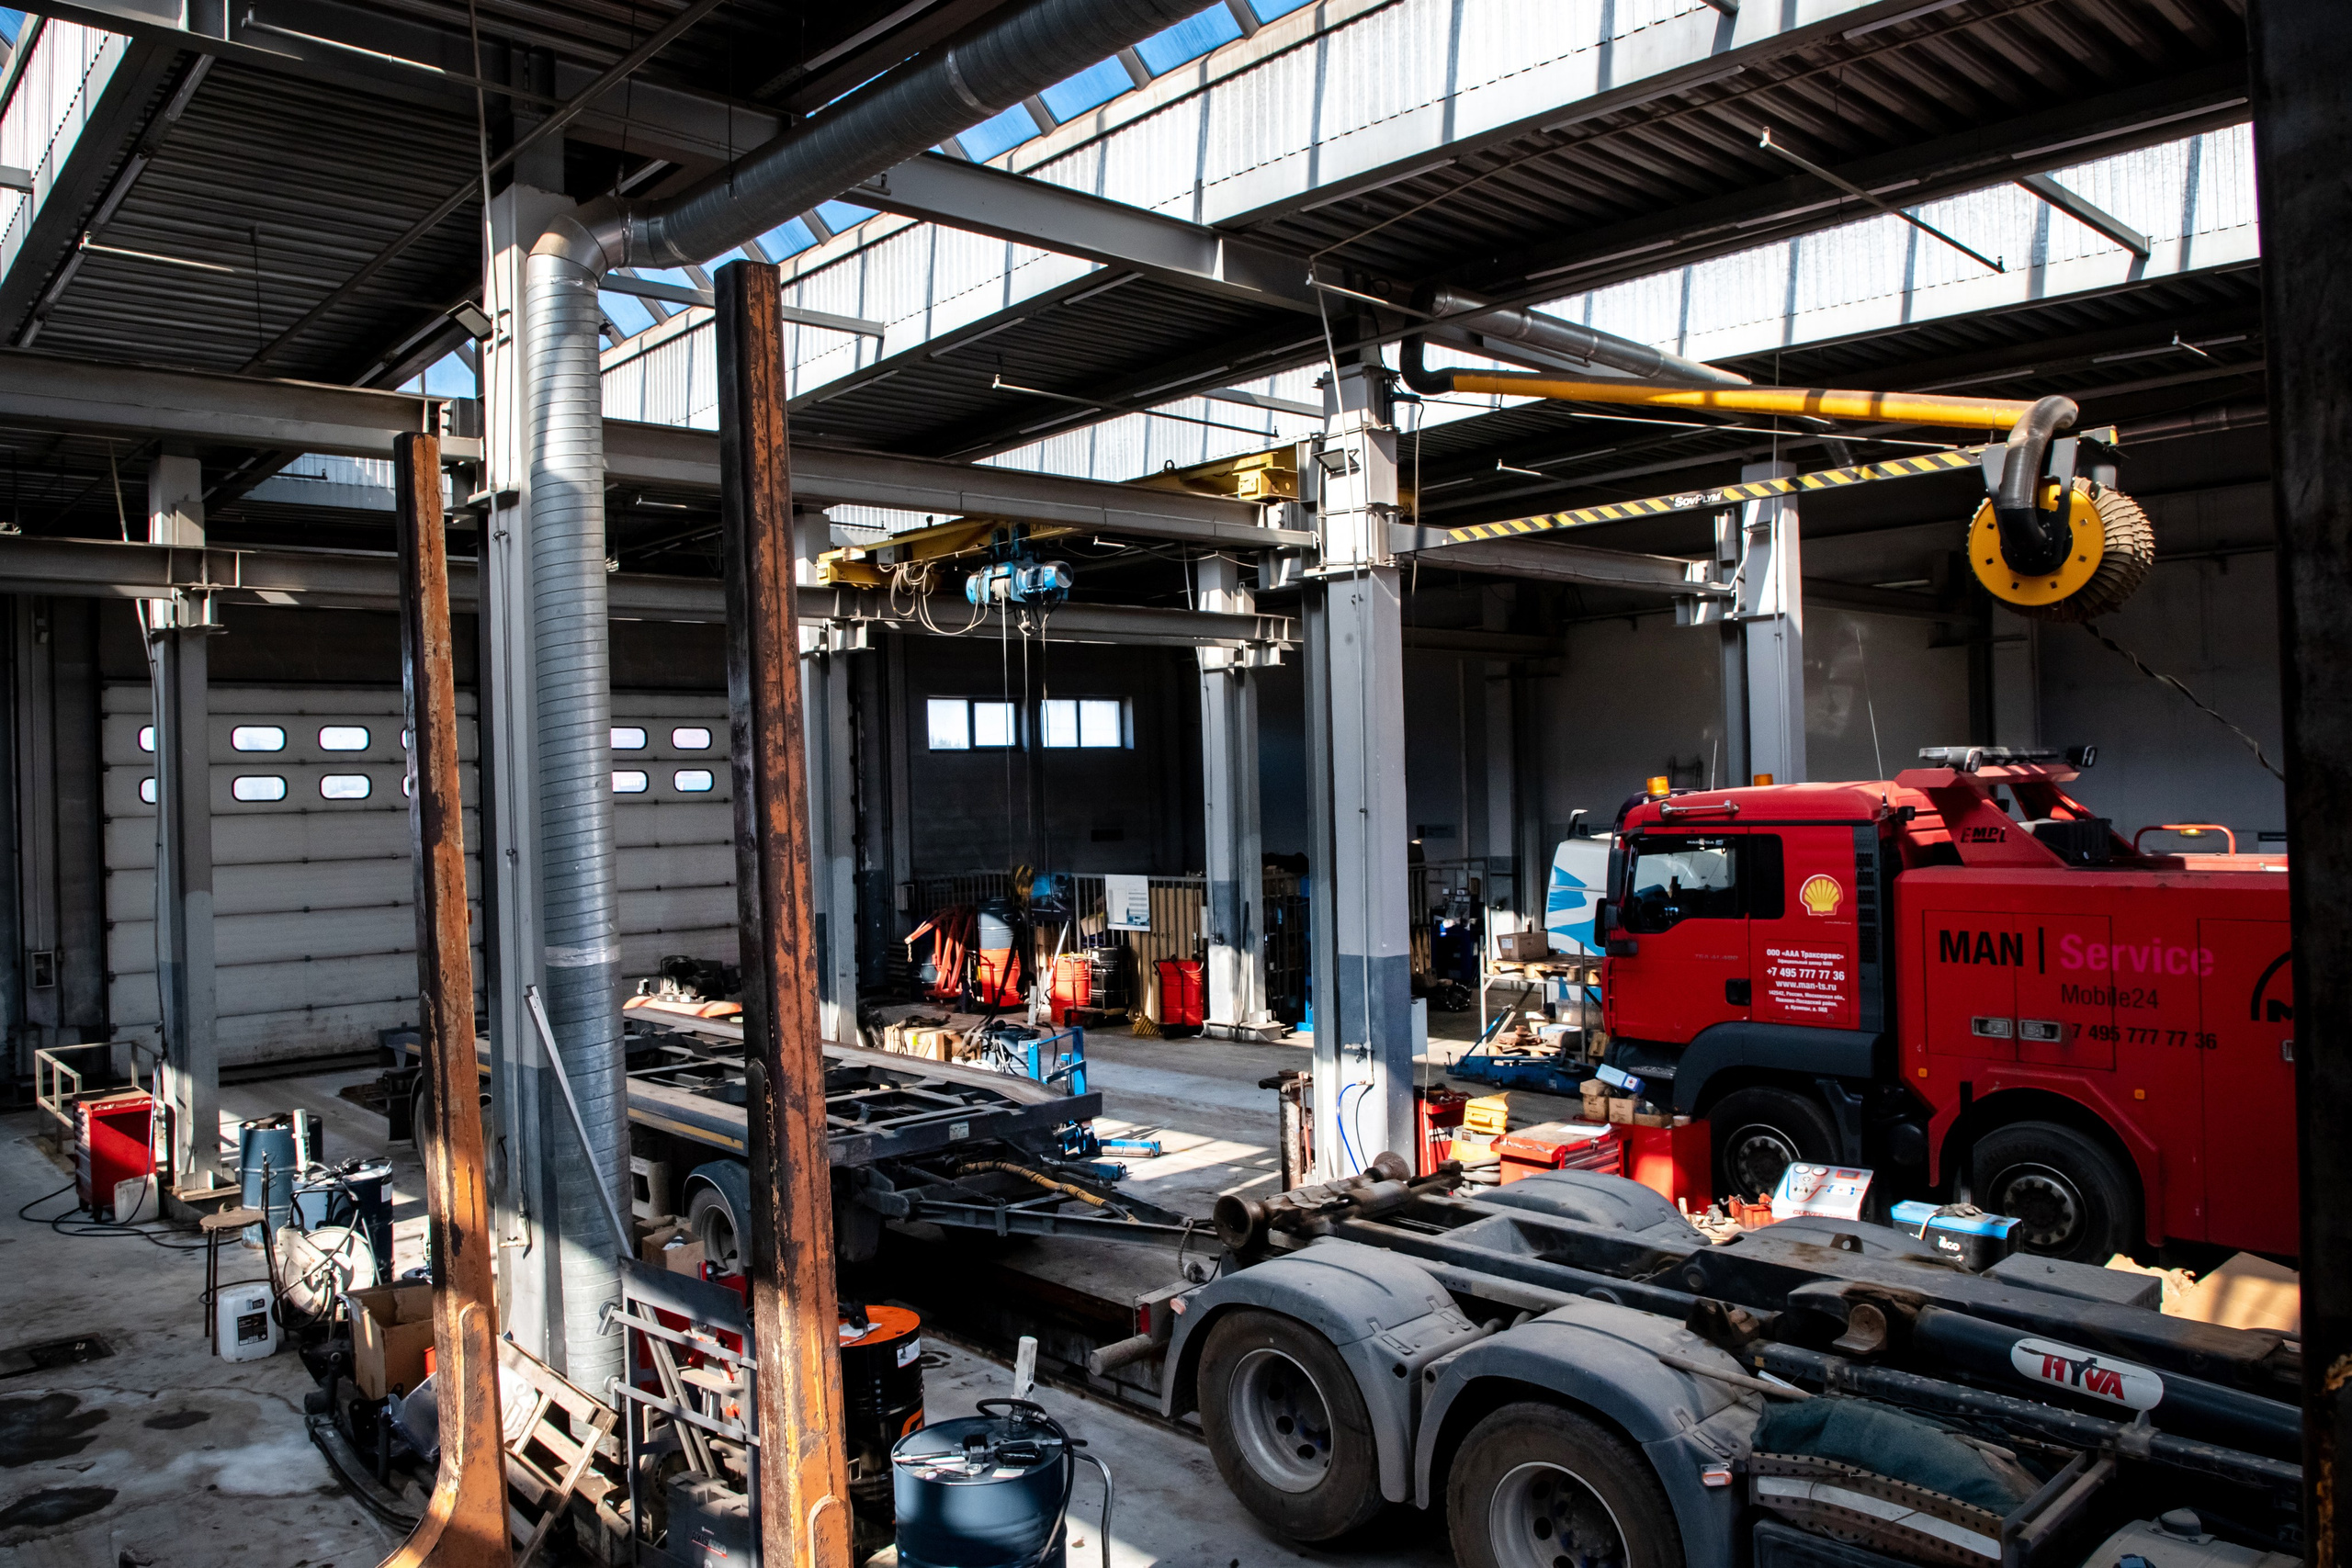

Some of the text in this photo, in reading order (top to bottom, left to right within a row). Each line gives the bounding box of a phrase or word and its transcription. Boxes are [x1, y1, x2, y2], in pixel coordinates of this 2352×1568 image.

[1939, 930, 2214, 976] MAN Service
[1766, 966, 1845, 981] +7 495 777 77 36
[1775, 980, 1838, 991] www.man-ts.ru
[2061, 983, 2160, 1010] Mobile24
[2072, 1023, 2218, 1050] 7 495 777 77 36
